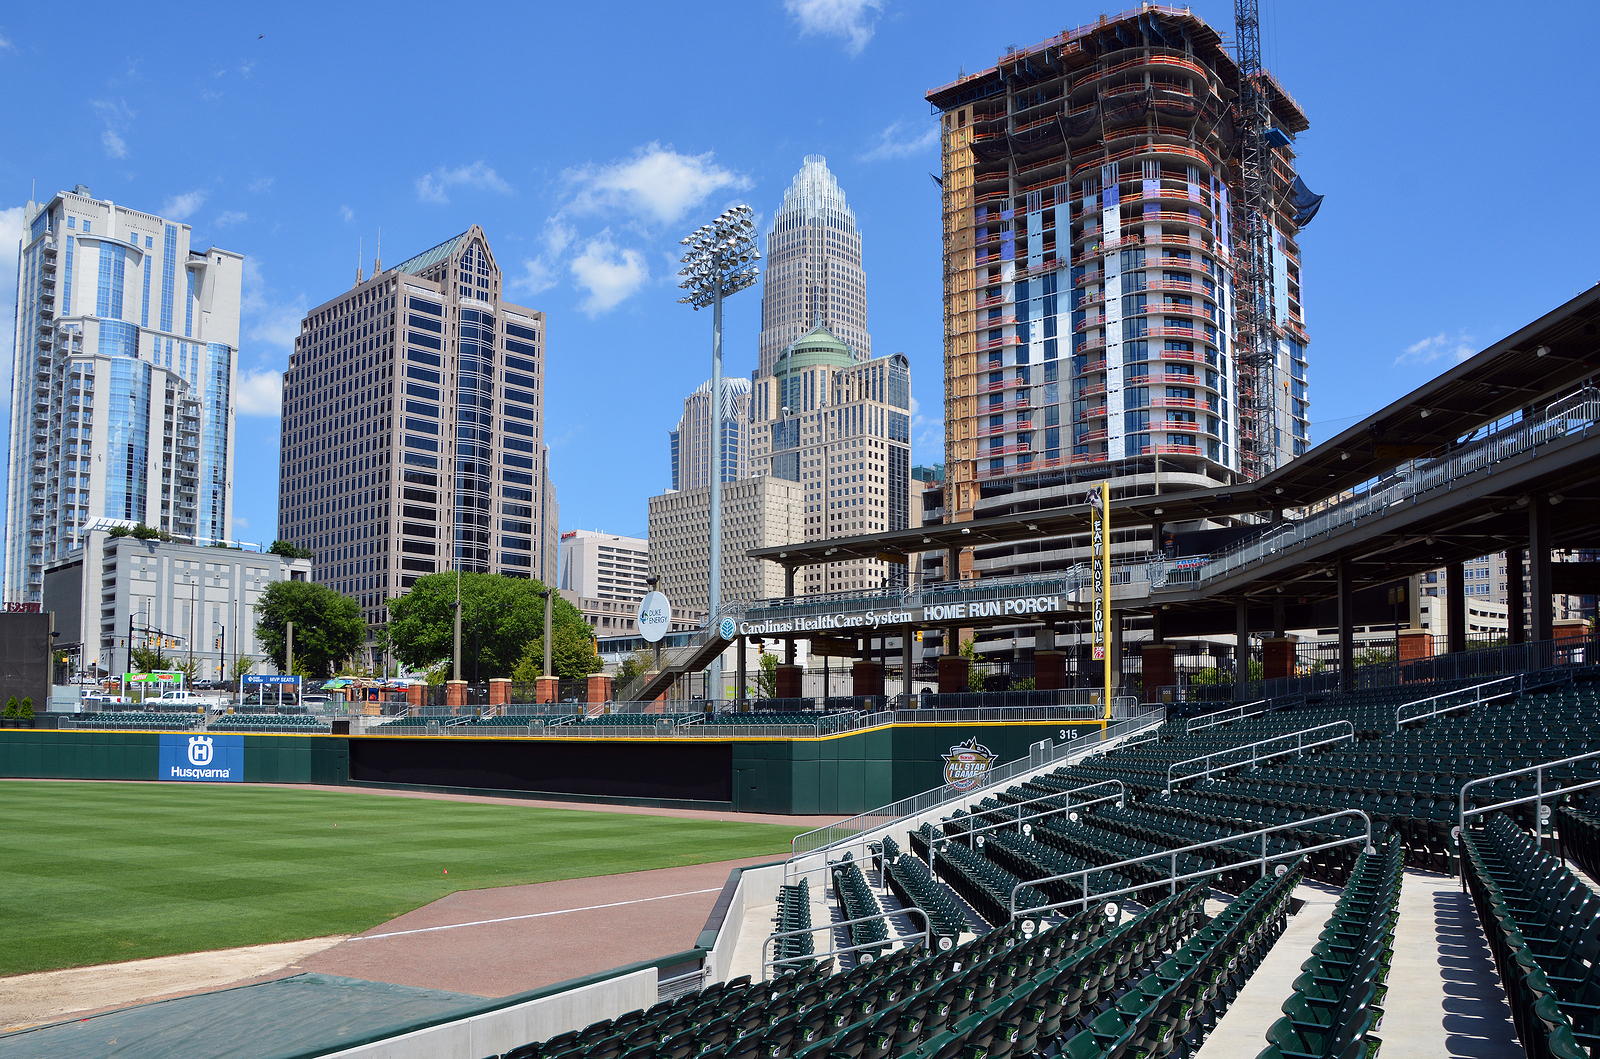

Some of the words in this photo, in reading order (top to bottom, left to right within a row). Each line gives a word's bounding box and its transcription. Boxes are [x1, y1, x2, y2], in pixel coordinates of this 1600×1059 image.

[1093, 520, 1103, 556] EAT
[1093, 560, 1103, 594] MOR
[648, 609, 662, 617] DUKE
[923, 605, 965, 621] HOME
[969, 601, 1001, 618] RUN
[1004, 596, 1060, 615] PORCH
[648, 617, 668, 625] ENERGY
[740, 620, 793, 635] Carolinas
[794, 614, 863, 631] HealthCare
[865, 611, 913, 630] System
[1094, 598, 1104, 644] FOWL
[1059, 729, 1078, 740] 315
[170, 766, 230, 779] Husqvarna
